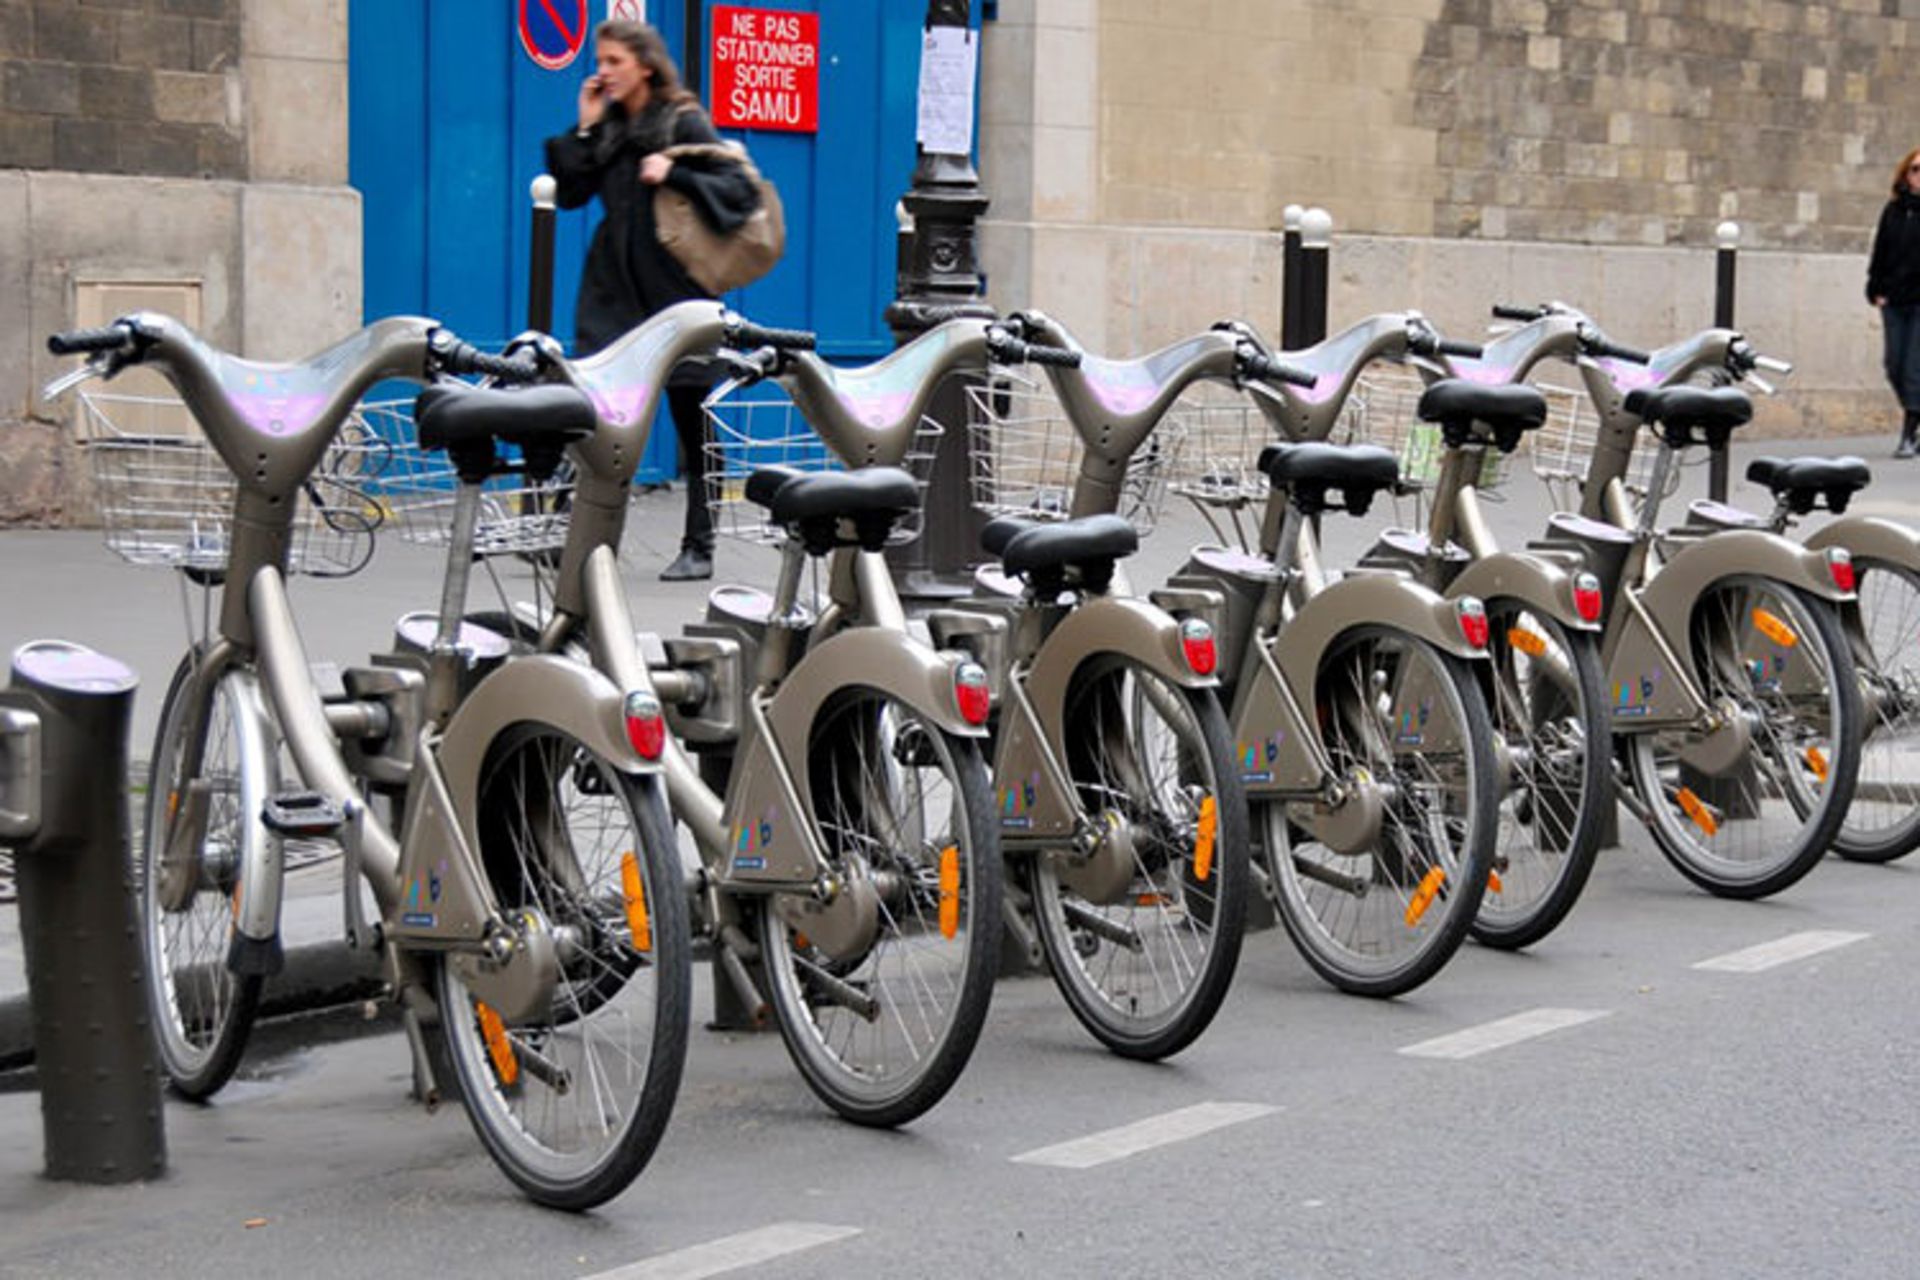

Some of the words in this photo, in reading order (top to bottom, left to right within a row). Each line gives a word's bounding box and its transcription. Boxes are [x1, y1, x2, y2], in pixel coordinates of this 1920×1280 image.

[731, 13, 756, 37] NE
[765, 15, 800, 41] PAS
[716, 36, 815, 67] STATIONNER
[735, 63, 797, 90] SORTIE
[730, 88, 801, 124] SAMU
